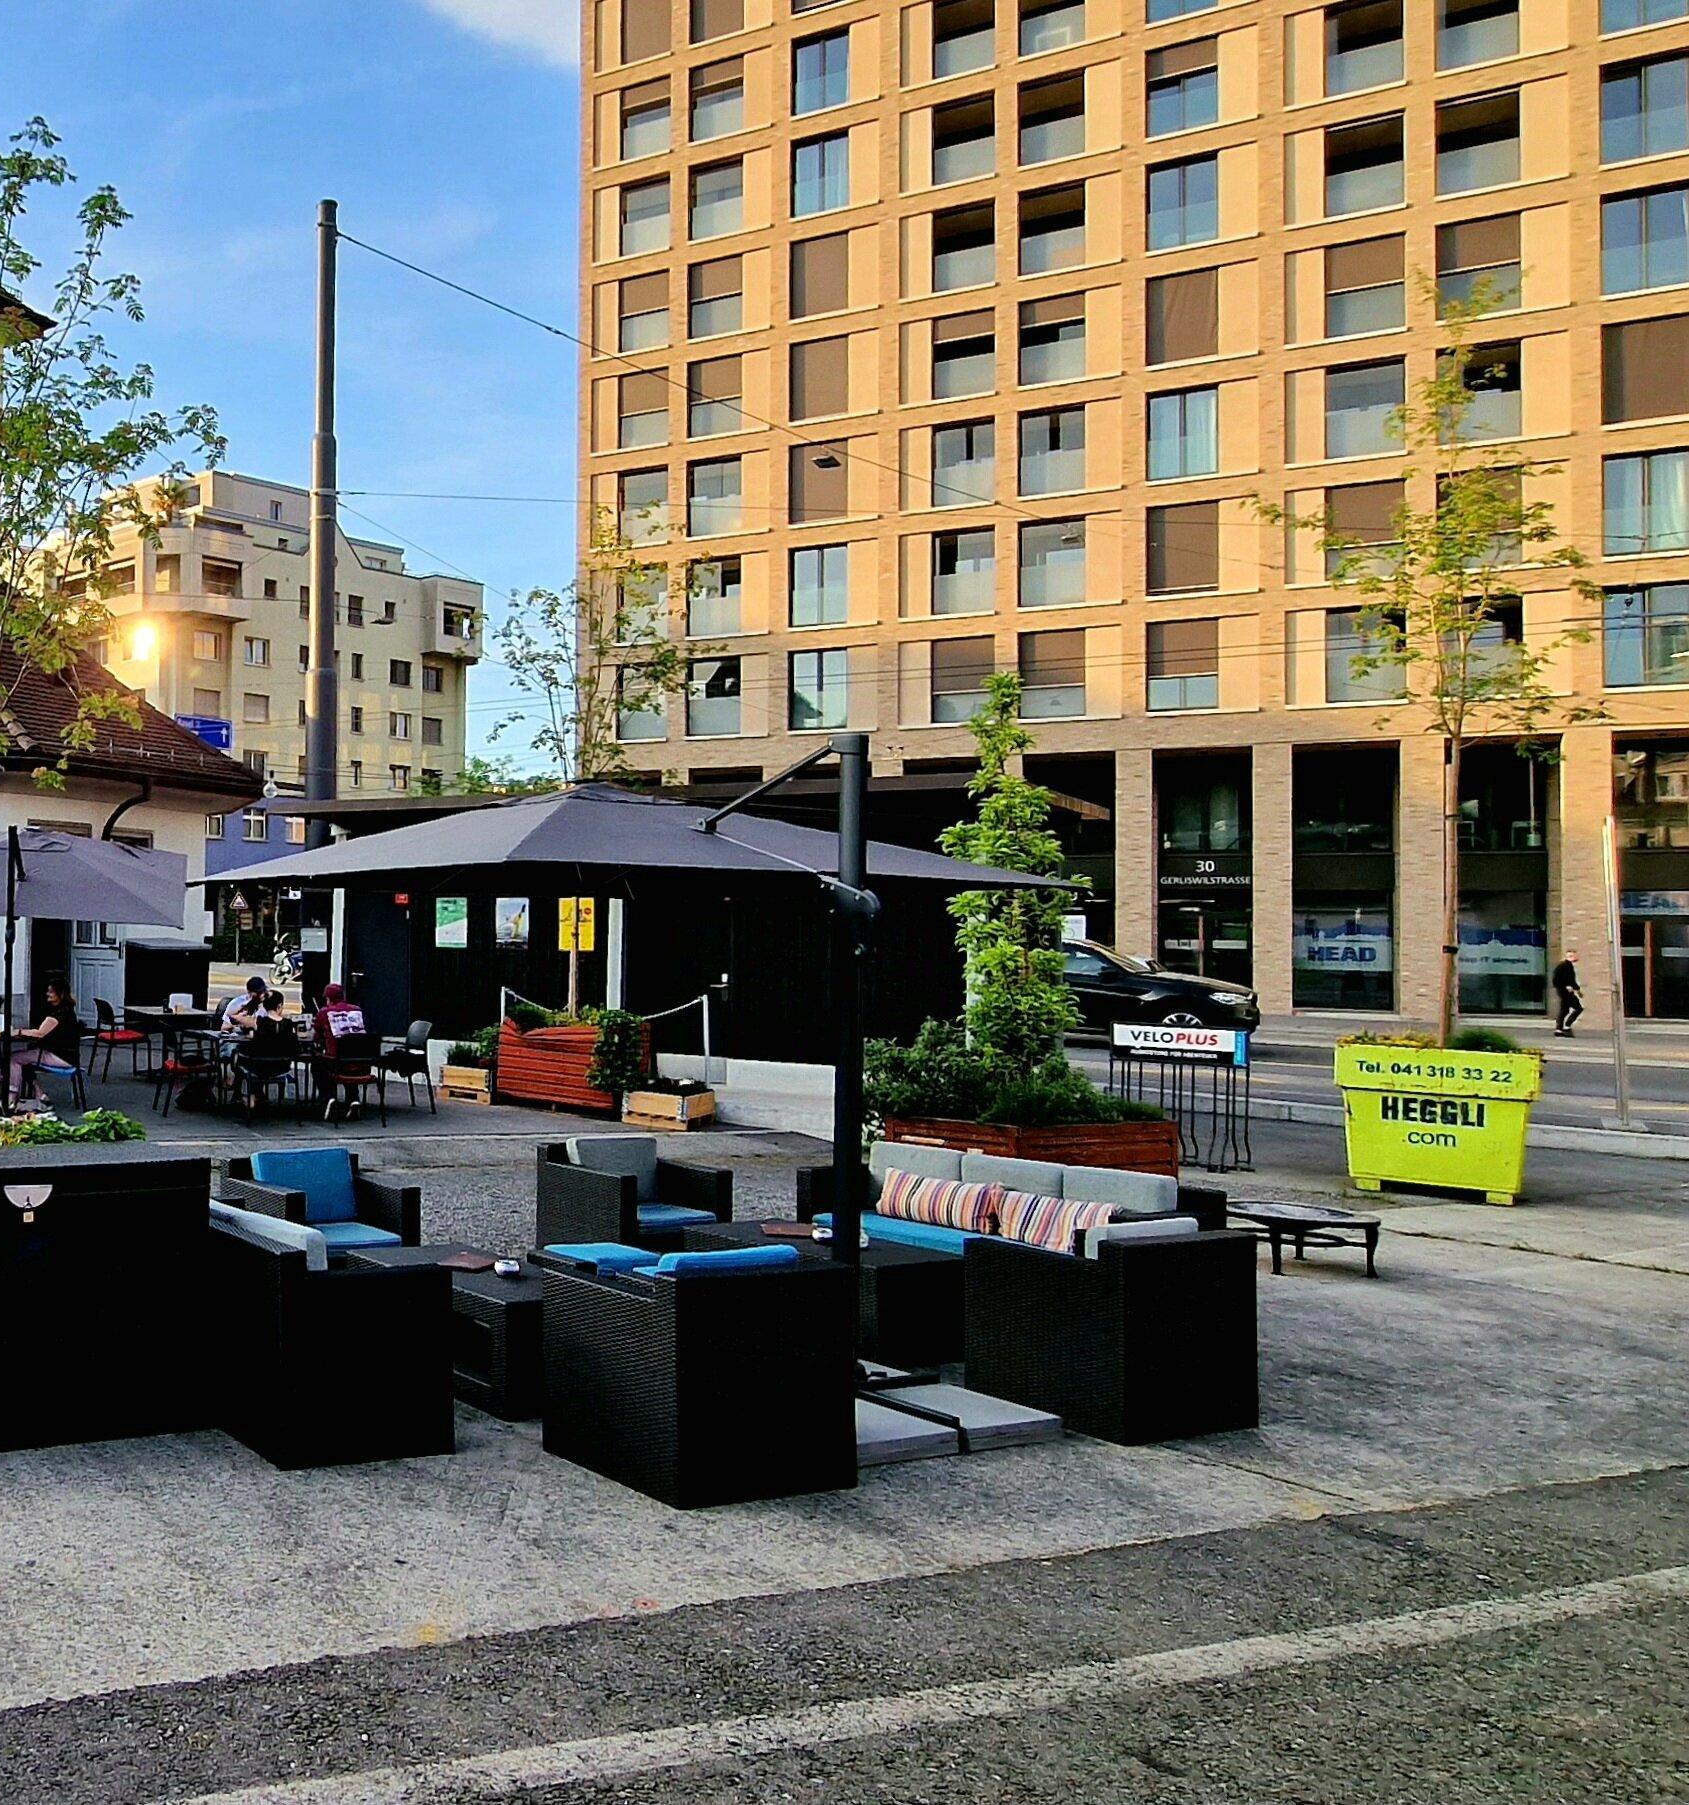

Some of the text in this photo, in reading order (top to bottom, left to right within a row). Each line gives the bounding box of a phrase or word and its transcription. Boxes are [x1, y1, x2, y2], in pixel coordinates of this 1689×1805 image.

[1195, 860, 1215, 873] 30
[1307, 946, 1377, 962] HEAD
[1130, 1030, 1218, 1046] VELOPLUS
[1356, 1060, 1513, 1083] Tel. 041 318 33 22
[1381, 1096, 1486, 1128] HEGGLI
[1402, 1131, 1457, 1147] .com
